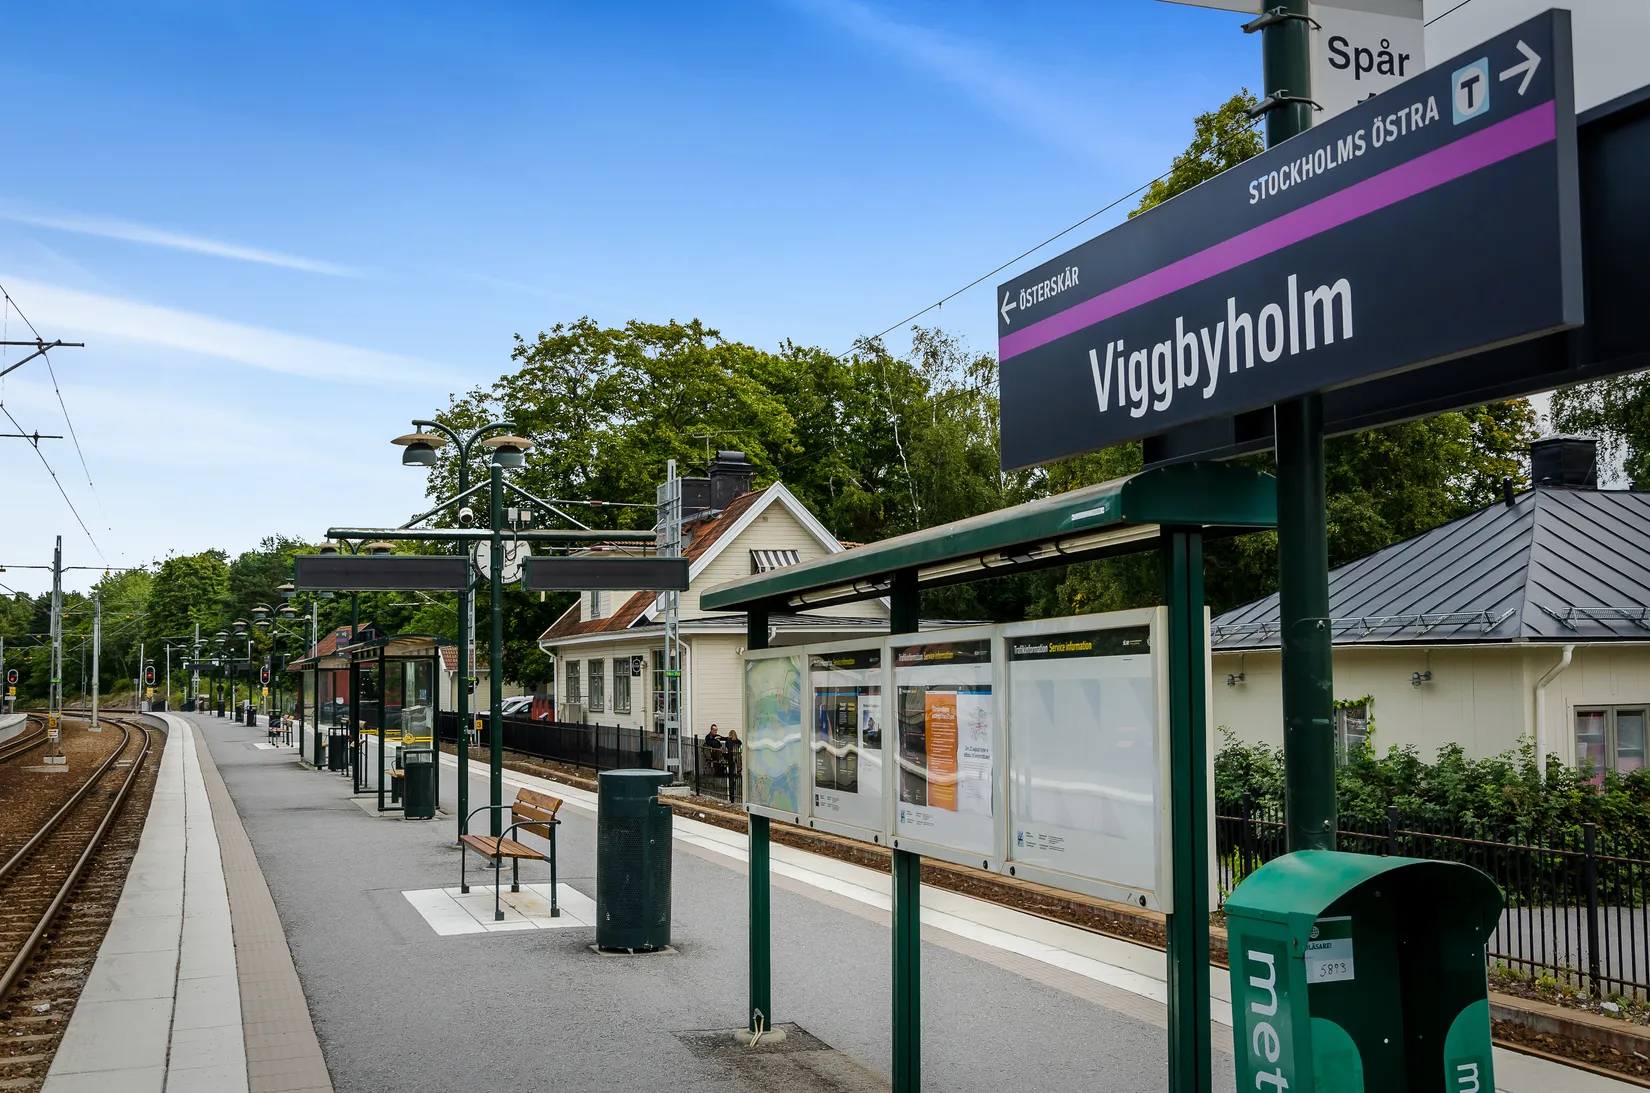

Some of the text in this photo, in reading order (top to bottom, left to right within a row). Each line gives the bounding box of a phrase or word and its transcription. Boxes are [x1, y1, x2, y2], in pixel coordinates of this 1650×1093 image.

[1327, 35, 1410, 80] Spår
[1249, 74, 1480, 204] STOCKHOLMS ÖSTRA T
[1019, 266, 1079, 311] ÖSTERSKÄR
[1088, 273, 1353, 419] Viggbyholm
[1049, 642, 1065, 653] Service
[1066, 640, 1093, 652] information
[50, 718, 56, 727] 3
[1319, 962, 1347, 978] 5893
